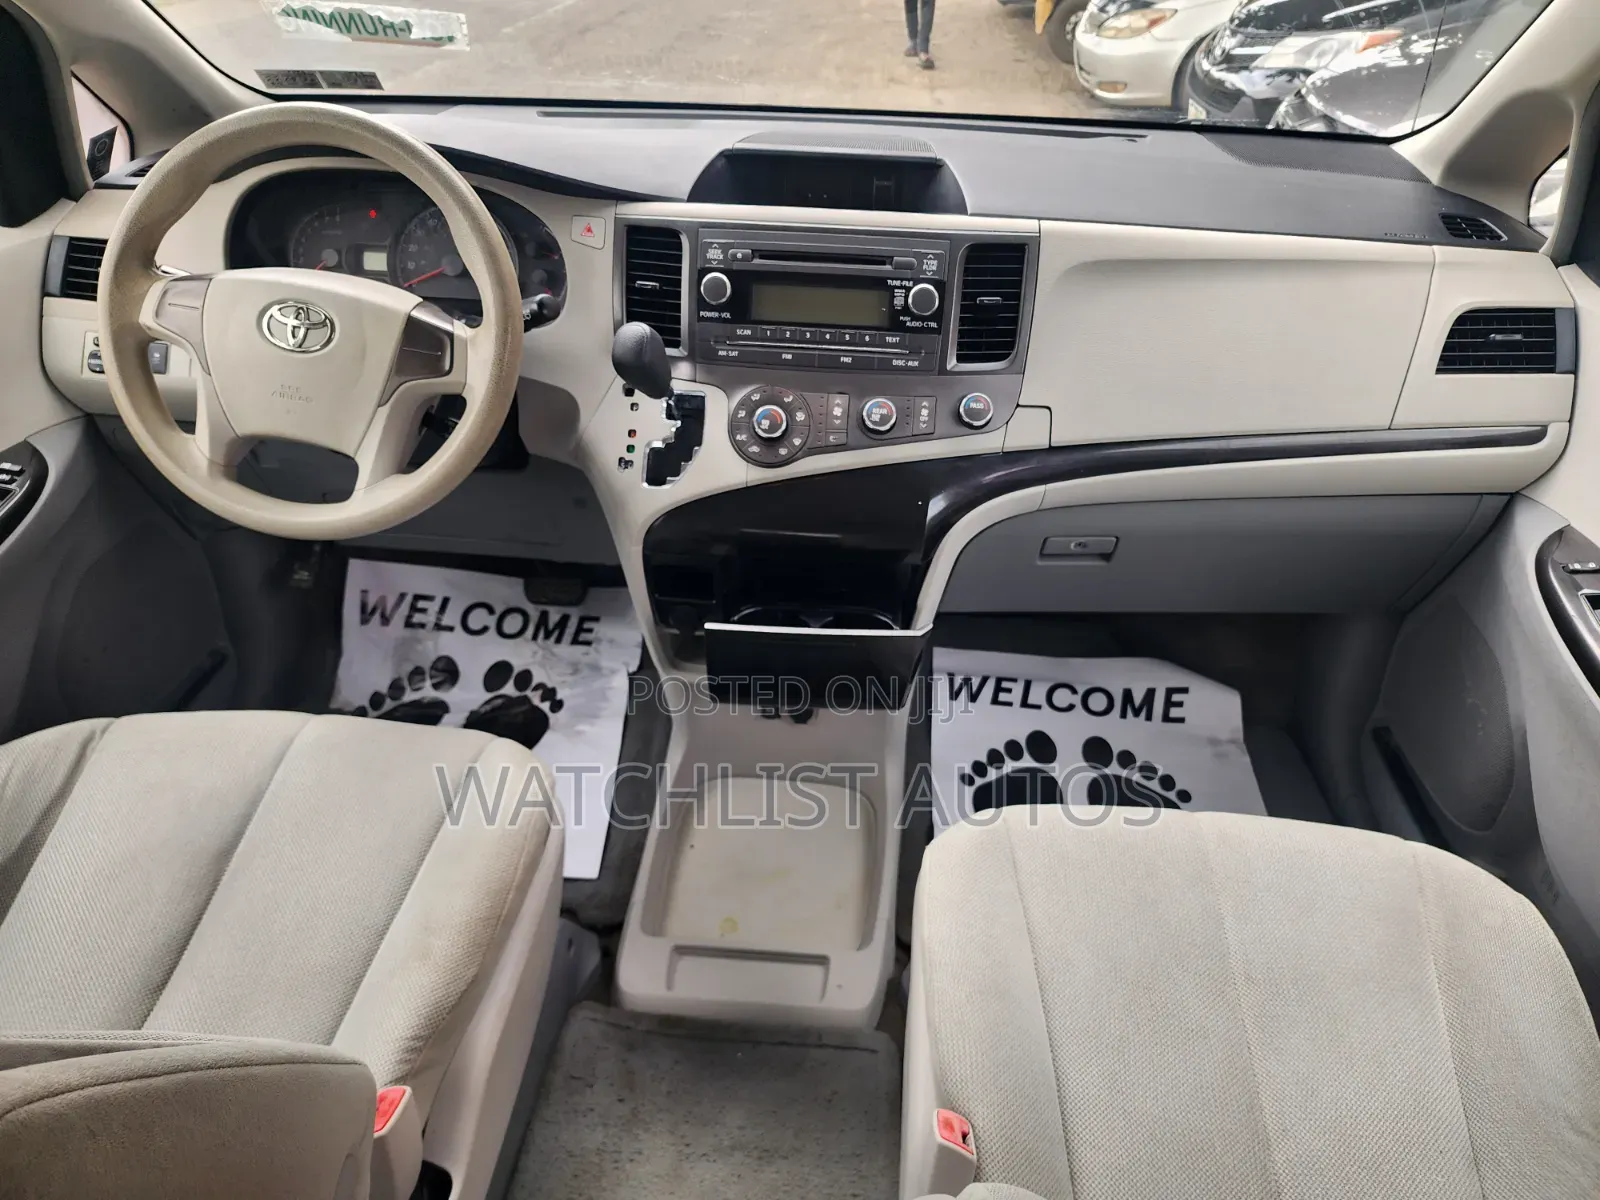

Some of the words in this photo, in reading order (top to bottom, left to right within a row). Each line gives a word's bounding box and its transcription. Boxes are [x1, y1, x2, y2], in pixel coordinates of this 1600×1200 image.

[970, 402, 985, 410] PASS
[359, 589, 601, 646] WELCOME
[946, 672, 1190, 724] WELCOME
